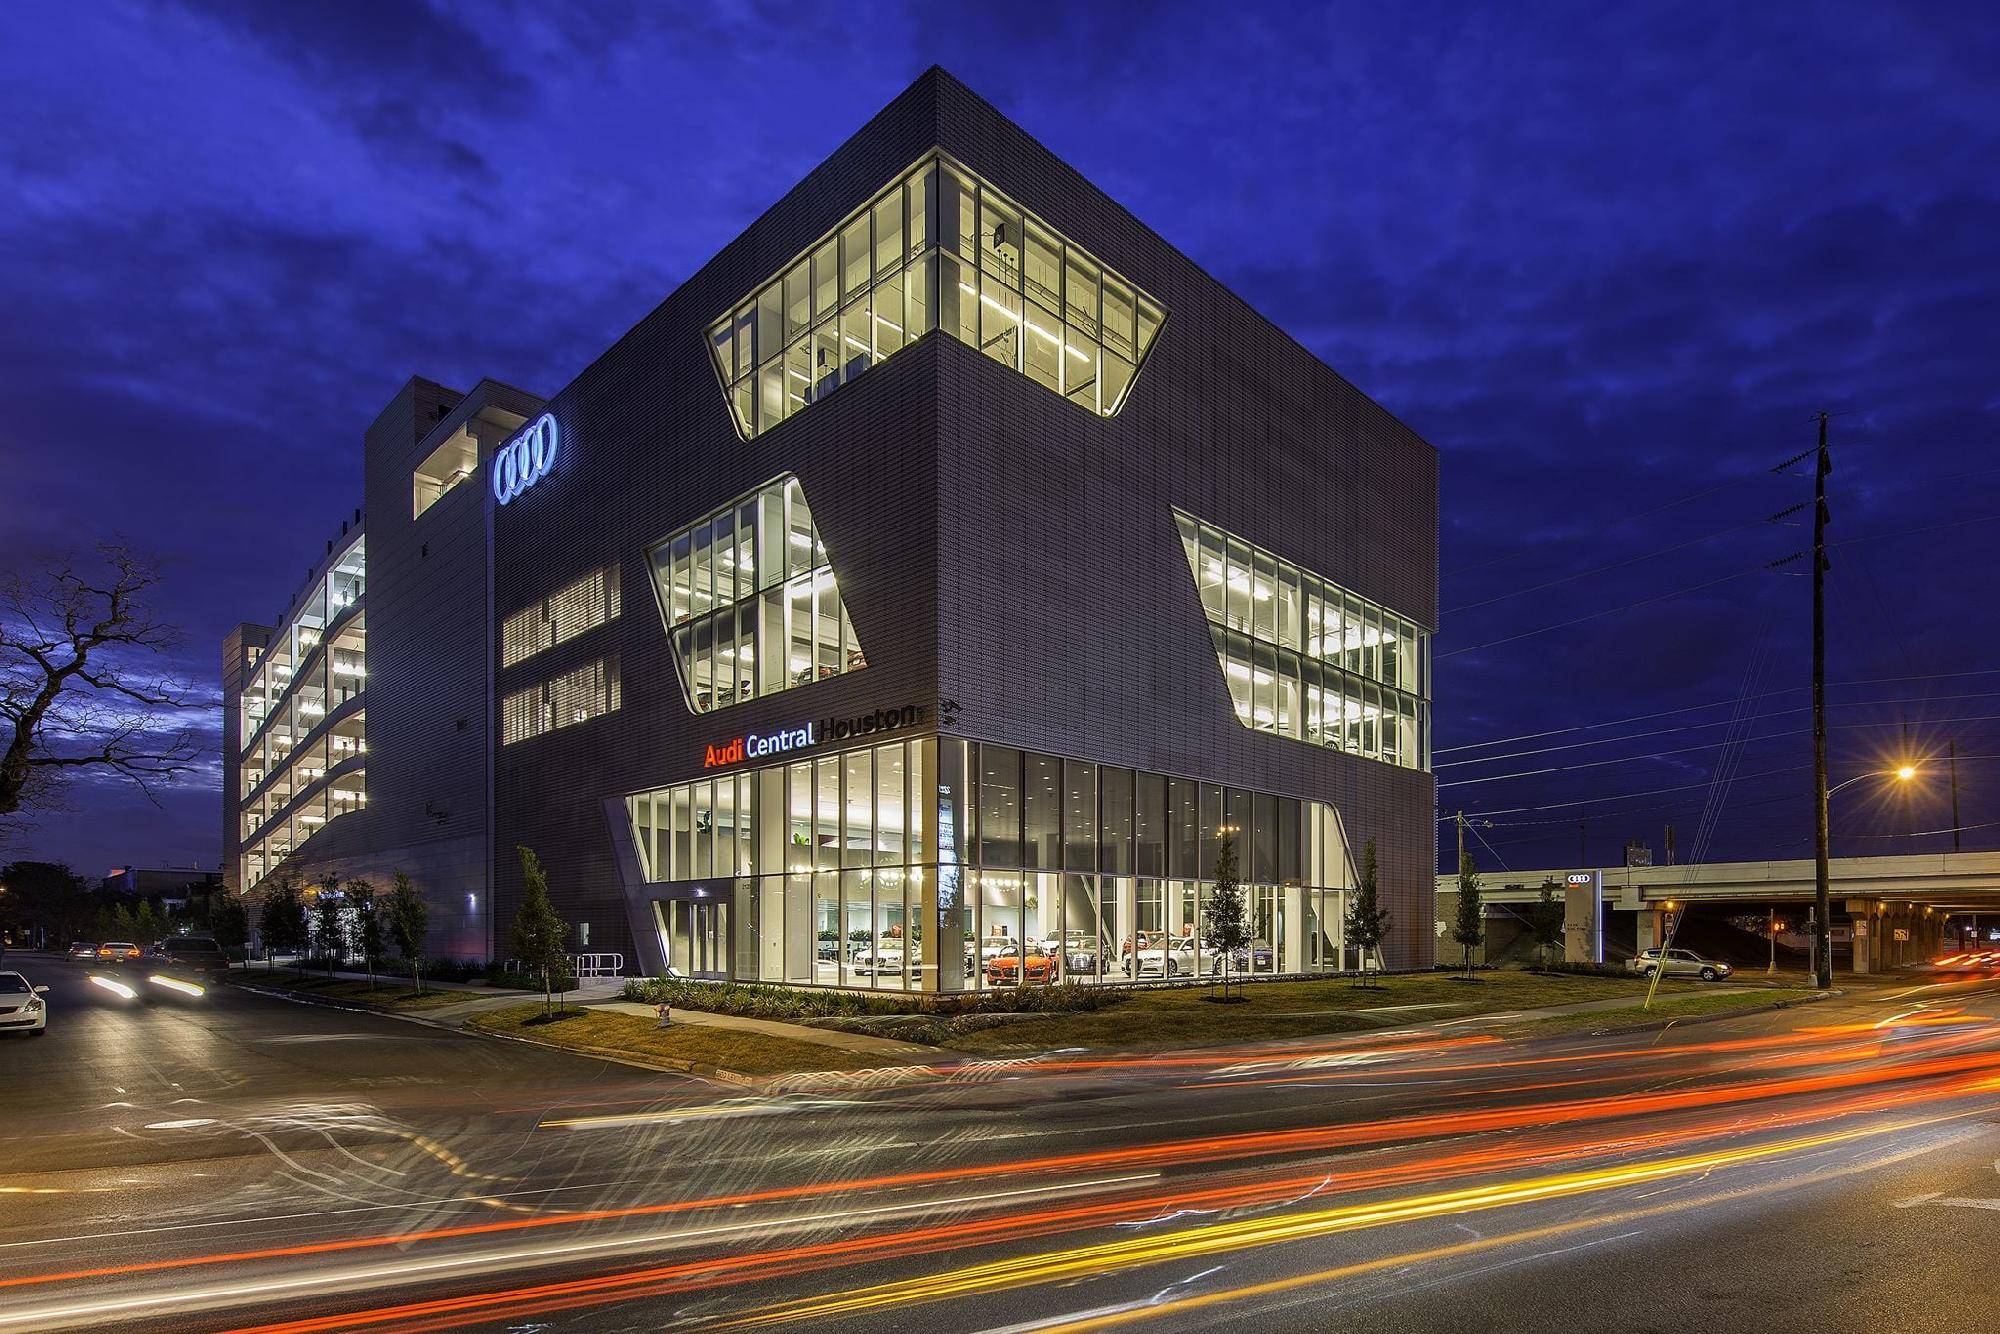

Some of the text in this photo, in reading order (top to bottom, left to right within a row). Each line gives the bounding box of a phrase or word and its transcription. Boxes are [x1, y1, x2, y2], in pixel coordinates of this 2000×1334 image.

[704, 705, 916, 768] Audi Central Houston
